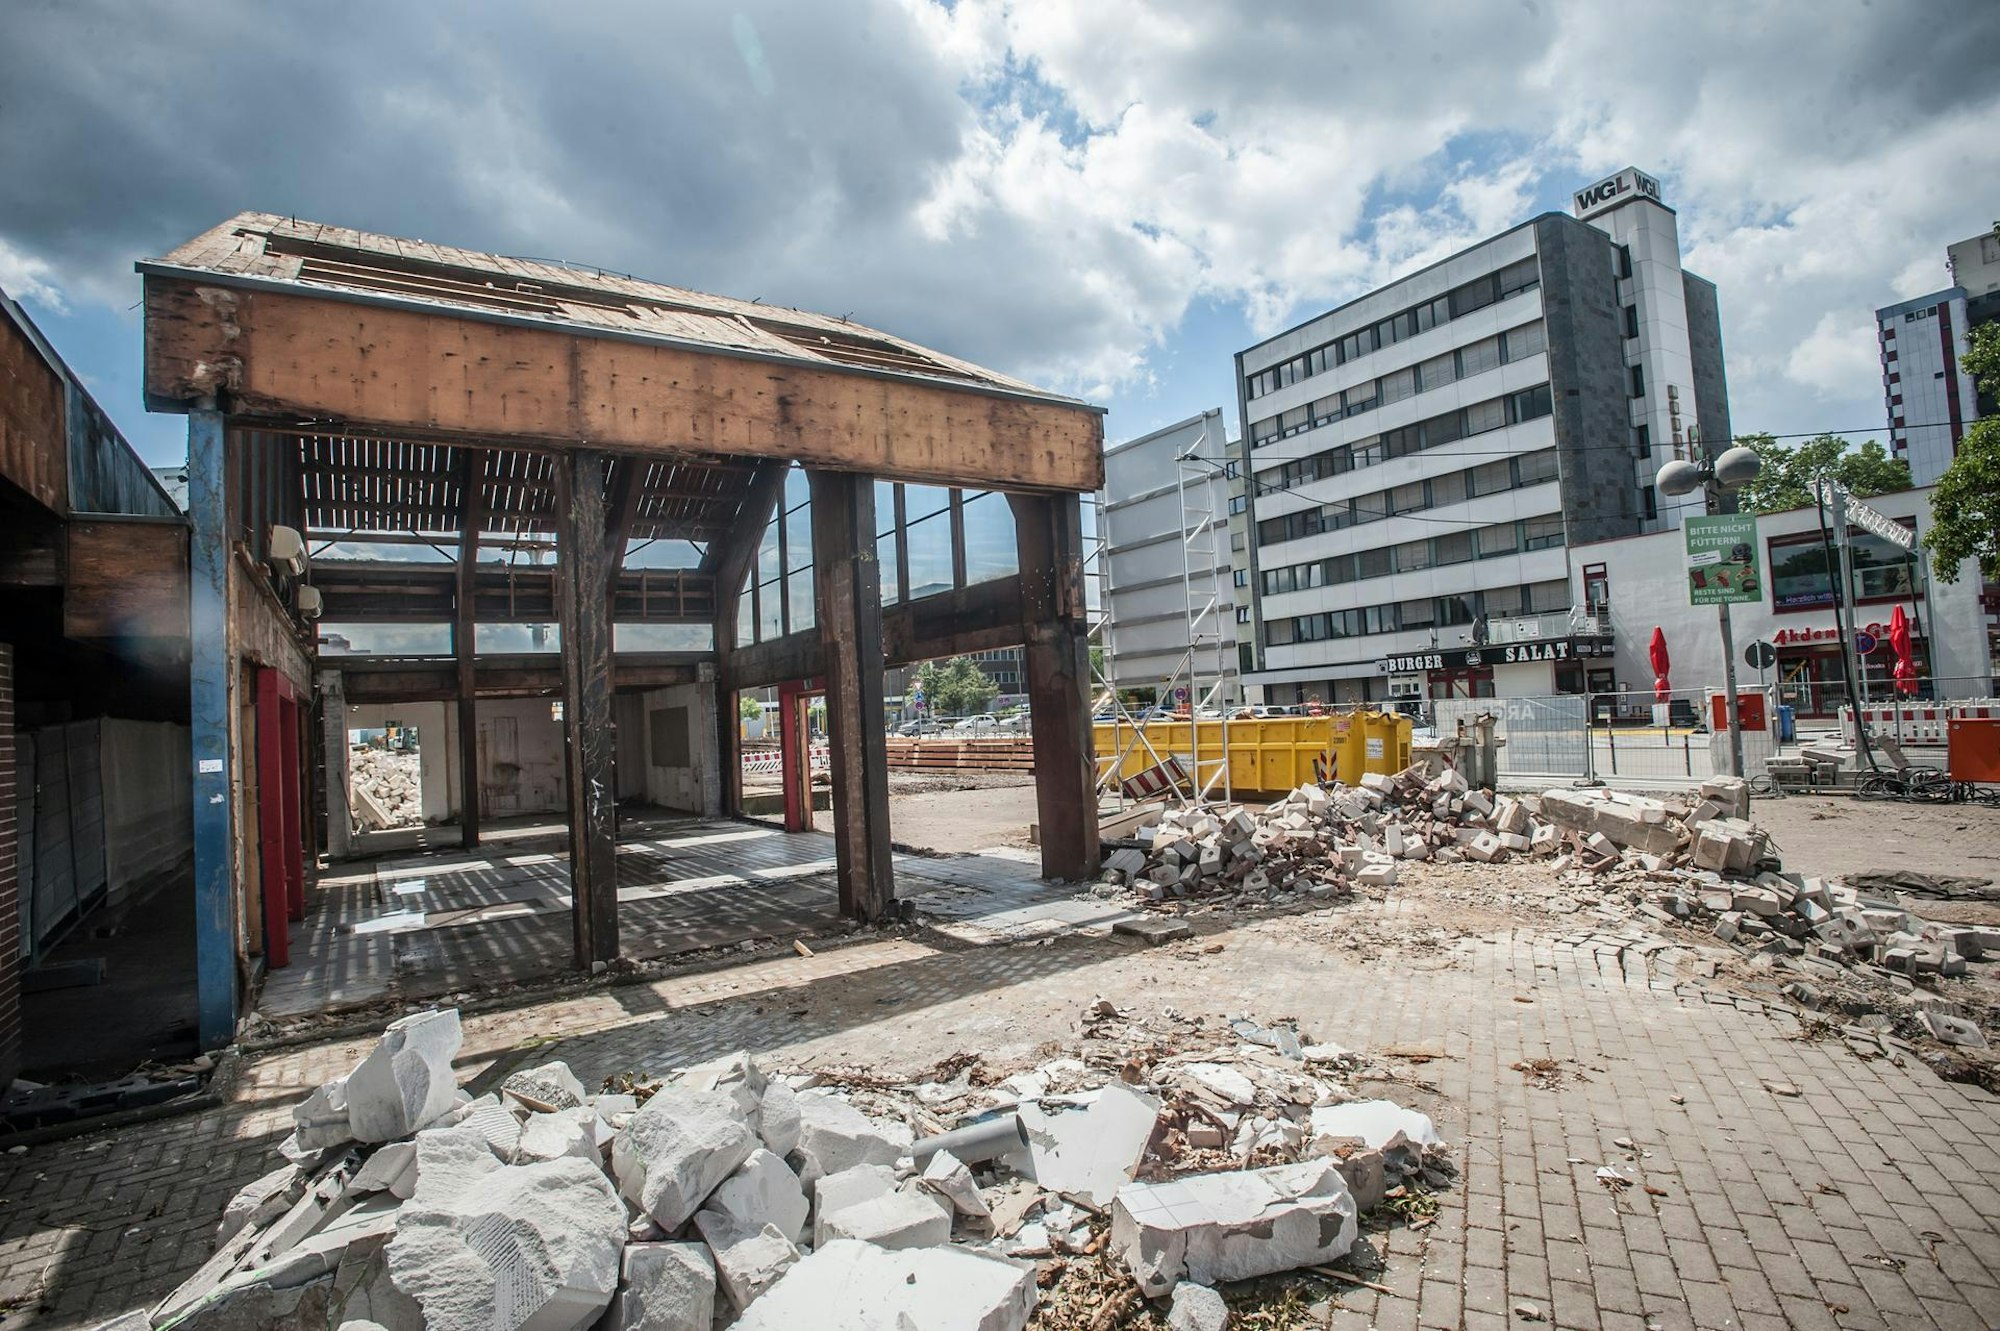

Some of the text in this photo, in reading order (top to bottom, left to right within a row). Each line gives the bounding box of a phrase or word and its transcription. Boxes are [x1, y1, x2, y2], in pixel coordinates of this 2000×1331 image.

[1634, 172, 1660, 200] WGL
[1577, 176, 1631, 210] WGL
[1690, 524, 1752, 535] BITTE NICHT
[1690, 536, 1740, 547] FÜTTERN!
[1694, 587, 1735, 596] RESTE SIND
[1694, 595, 1709, 604] FÜR
[1505, 642, 1568, 662] SALAT
[1388, 655, 1443, 671] BURGER
